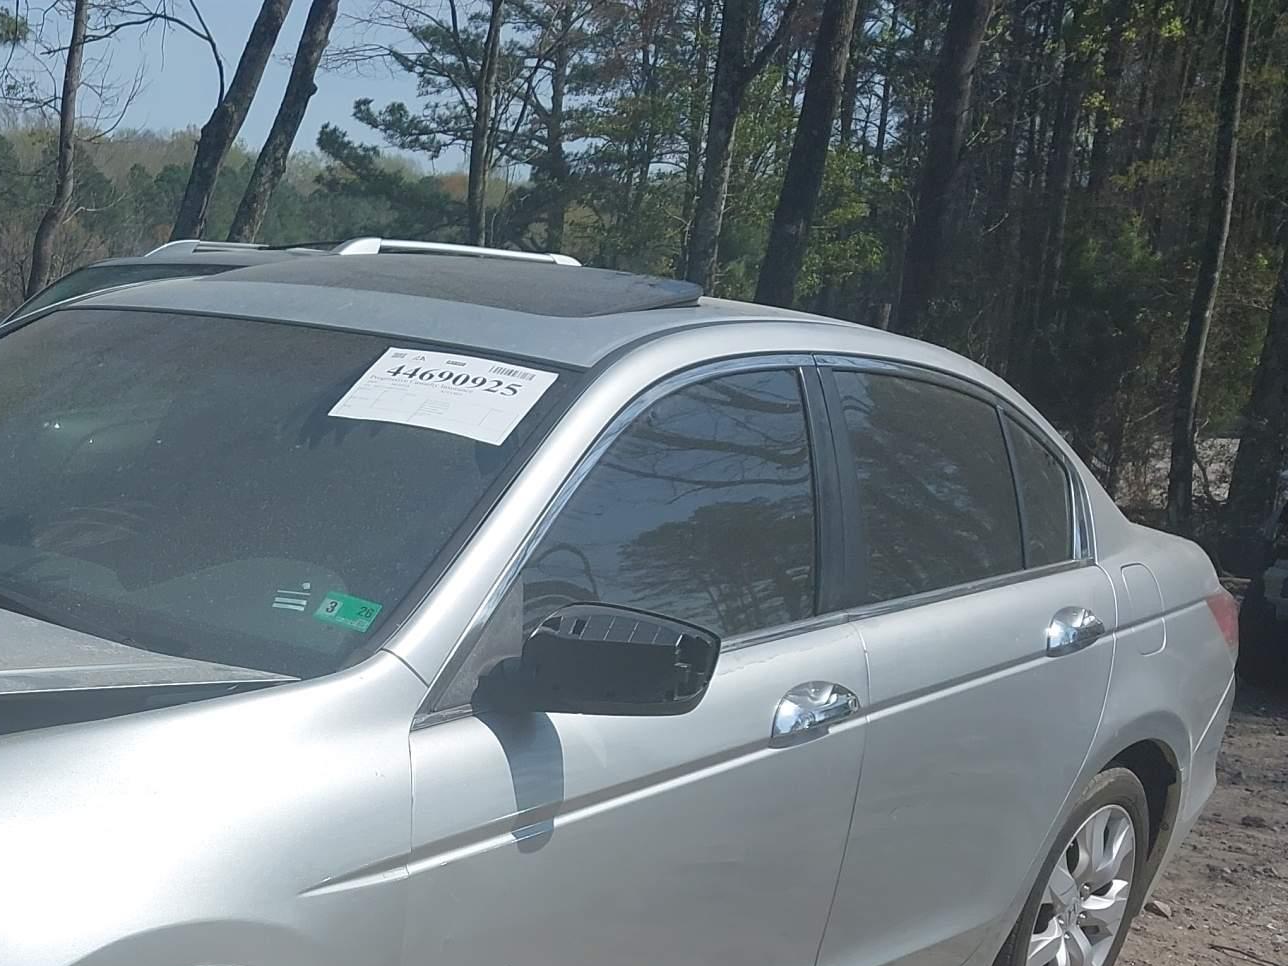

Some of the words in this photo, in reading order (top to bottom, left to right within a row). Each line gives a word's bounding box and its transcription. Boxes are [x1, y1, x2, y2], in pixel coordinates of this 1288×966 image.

[386, 364, 523, 398] 44690925
[325, 600, 338, 613] 3
[358, 606, 375, 618] 26
